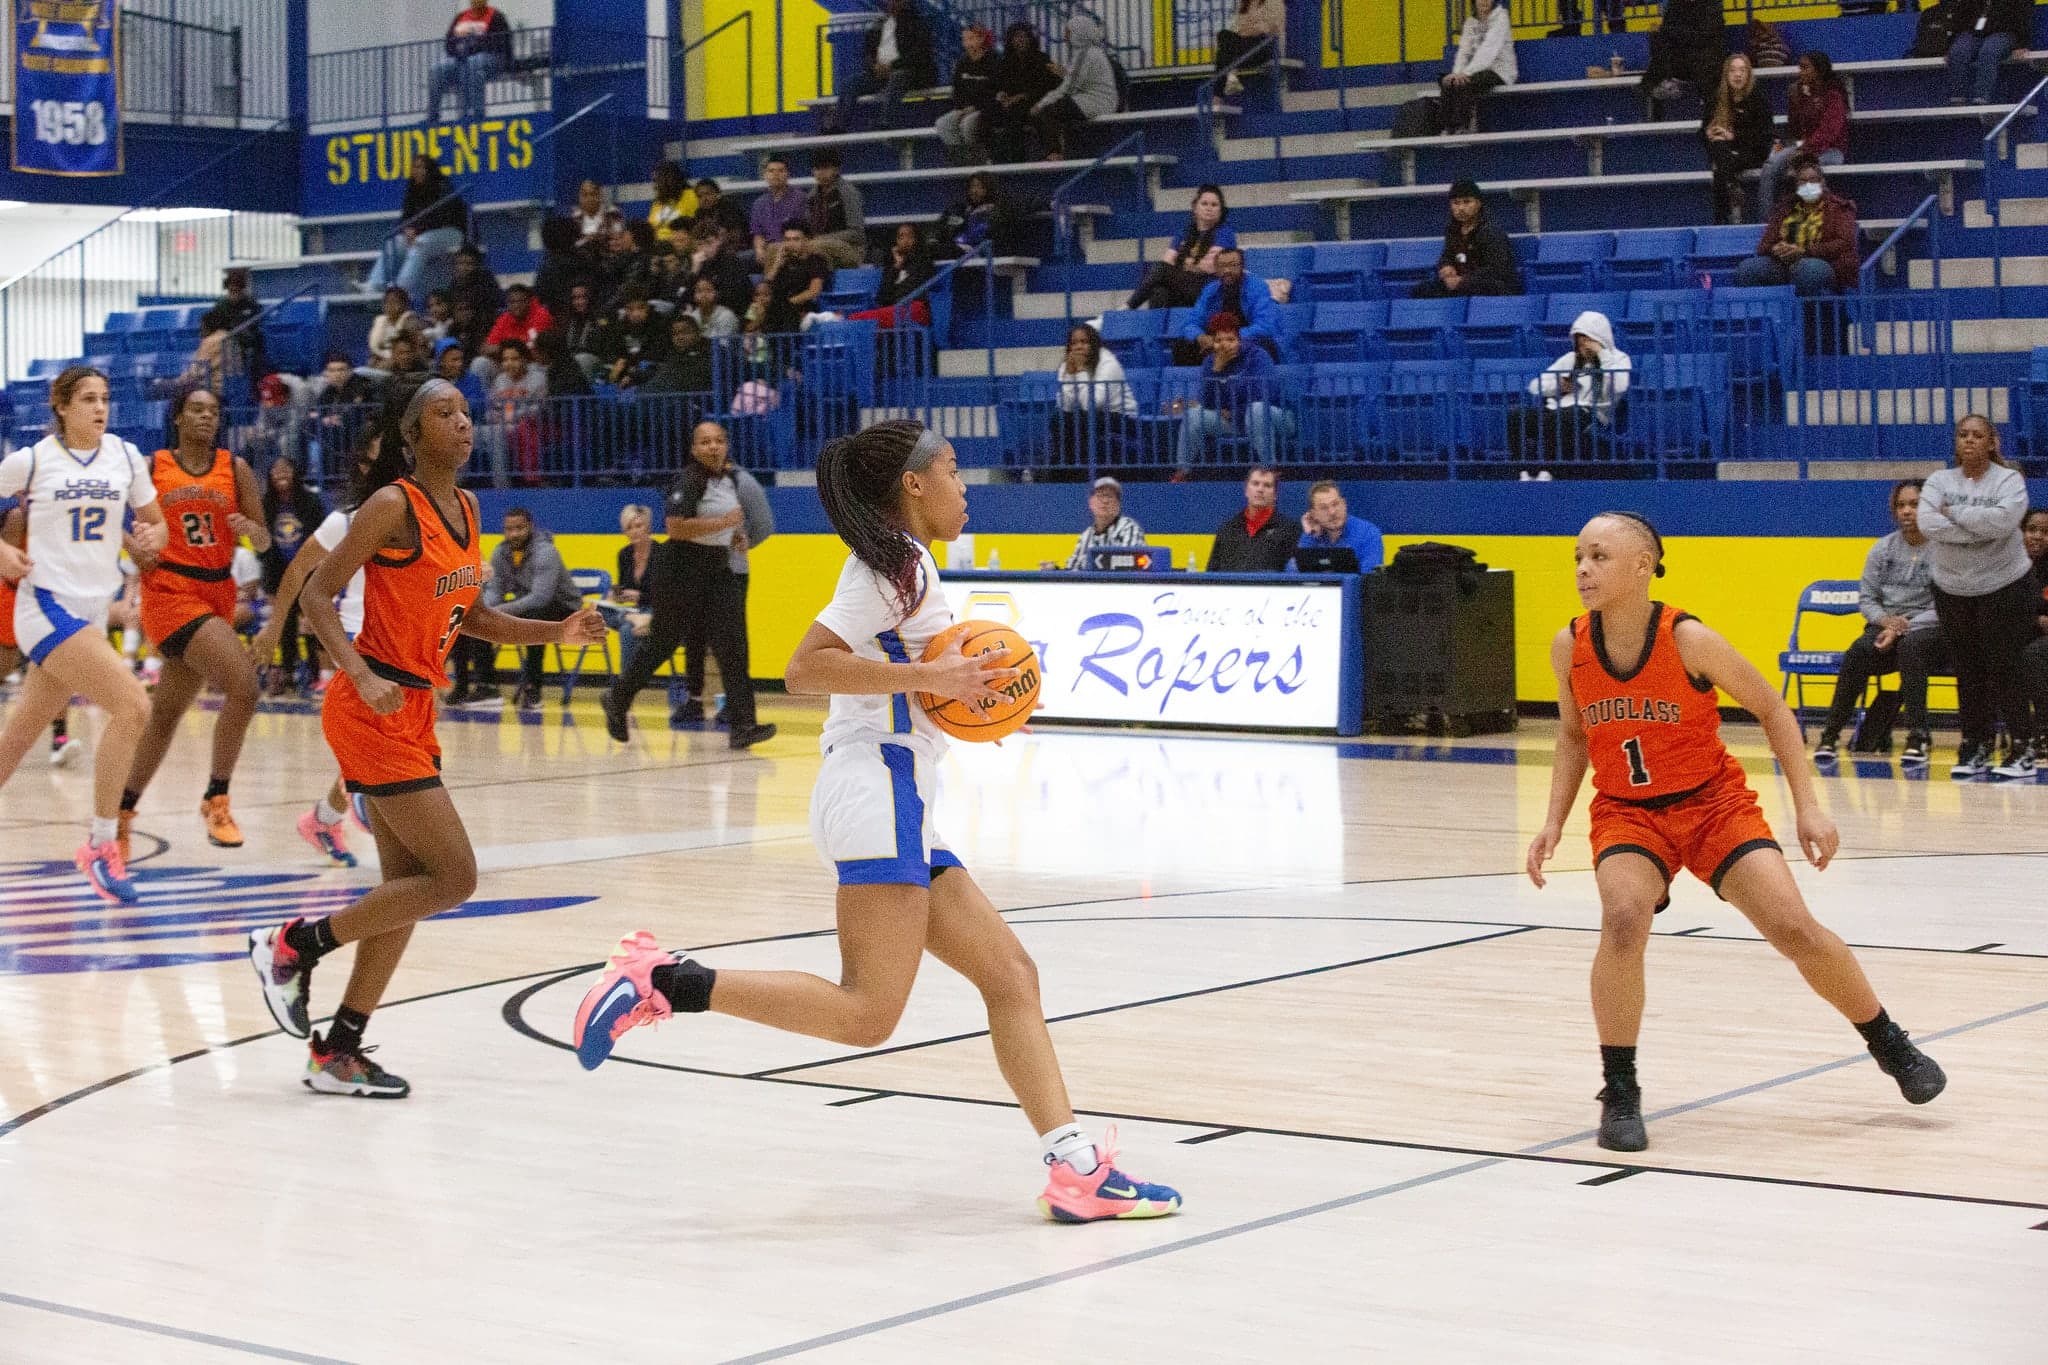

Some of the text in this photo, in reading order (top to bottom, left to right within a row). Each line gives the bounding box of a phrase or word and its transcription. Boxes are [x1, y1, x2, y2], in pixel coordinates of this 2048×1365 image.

[327, 118, 534, 185] STUDENTS
[54, 488, 120, 501] ROPERS
[65, 478, 110, 488] LADY
[68, 507, 107, 541] 12
[182, 512, 216, 546] 21
[434, 564, 482, 598] DOUGL
[1071, 612, 1308, 715] Ropers
[1621, 735, 1651, 787] 1
